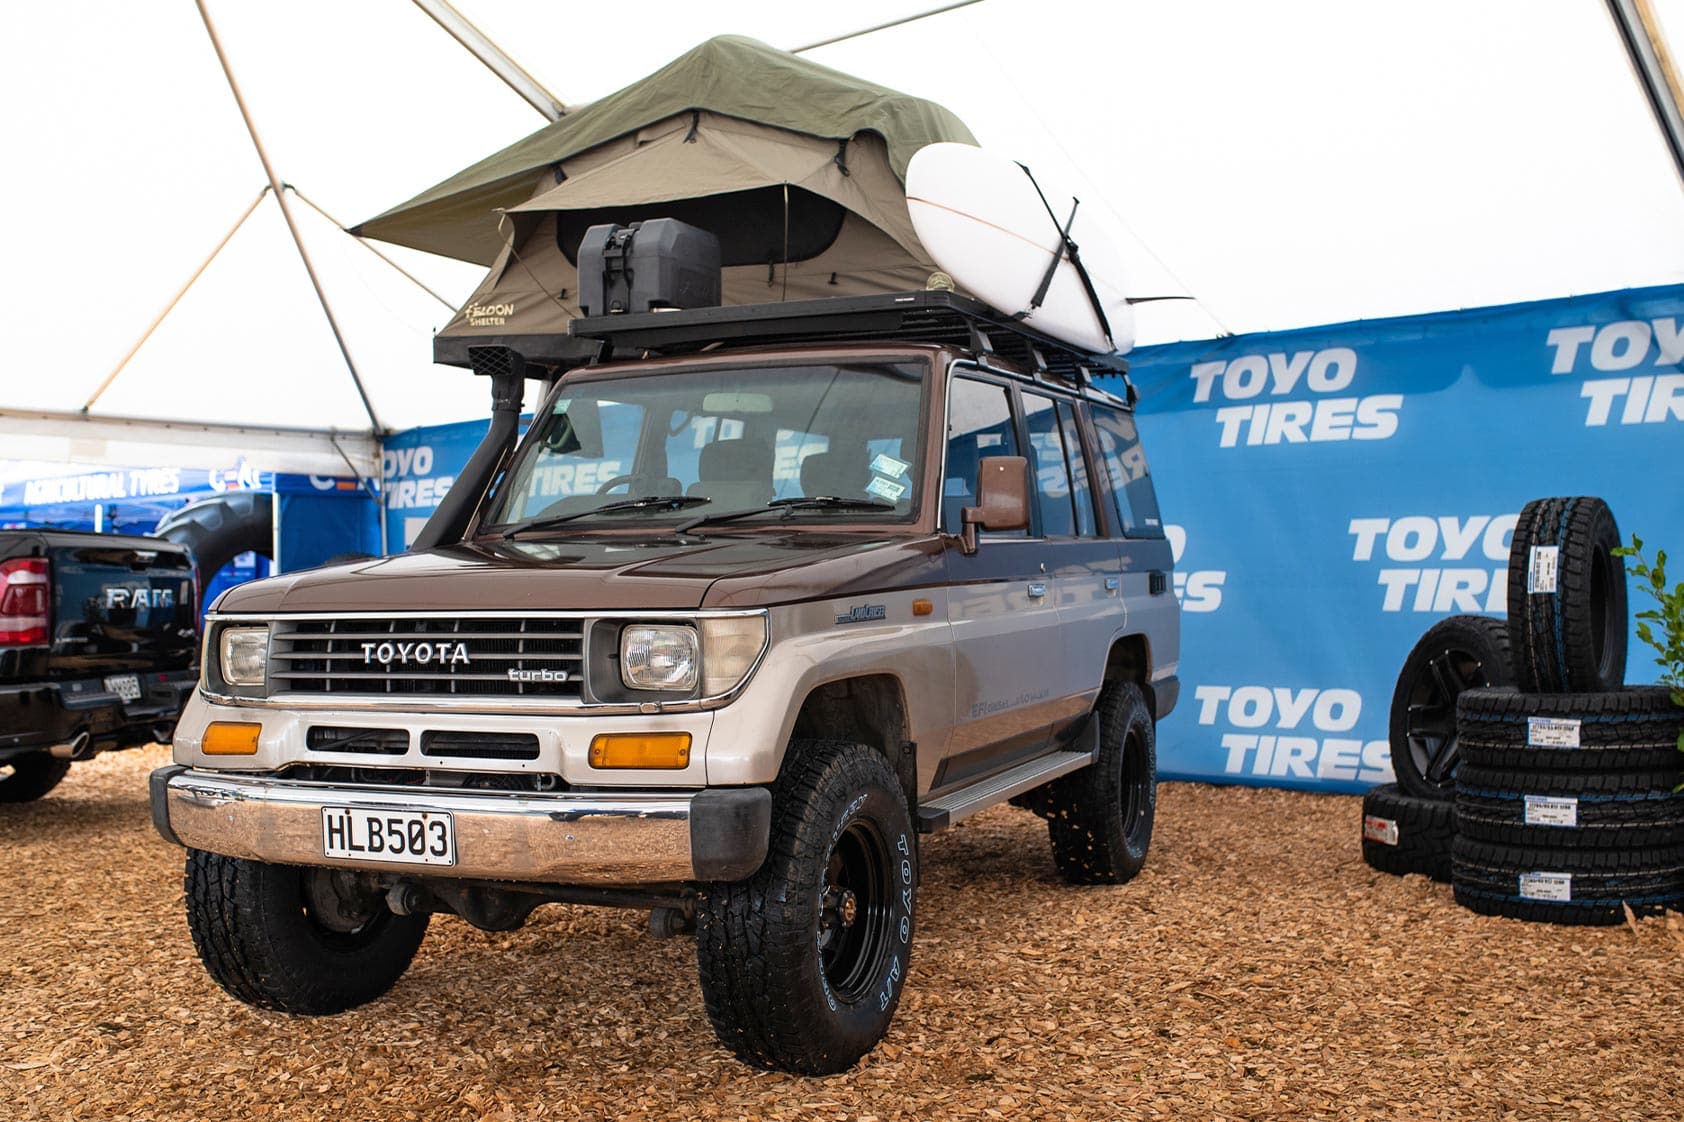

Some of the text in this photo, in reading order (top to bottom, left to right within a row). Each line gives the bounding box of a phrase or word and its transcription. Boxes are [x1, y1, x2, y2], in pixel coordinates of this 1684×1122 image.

[470, 317, 506, 328] SHELTER
[1546, 317, 1684, 375] TOY
[1190, 347, 1357, 403] TOYO
[1215, 394, 1404, 448] TIRES
[1580, 373, 1684, 427] TIR
[129, 467, 182, 497] TYRES
[383, 446, 434, 478] OYO
[105, 588, 173, 609] RAM
[1377, 568, 1509, 612] TIR
[361, 642, 471, 665] TOYOTA
[507, 667, 569, 682] turbo
[1194, 686, 1362, 732] TOYO
[1221, 734, 1398, 783] TIRES
[327, 814, 448, 857] HLB503
[897, 834, 912, 944] TOYO
